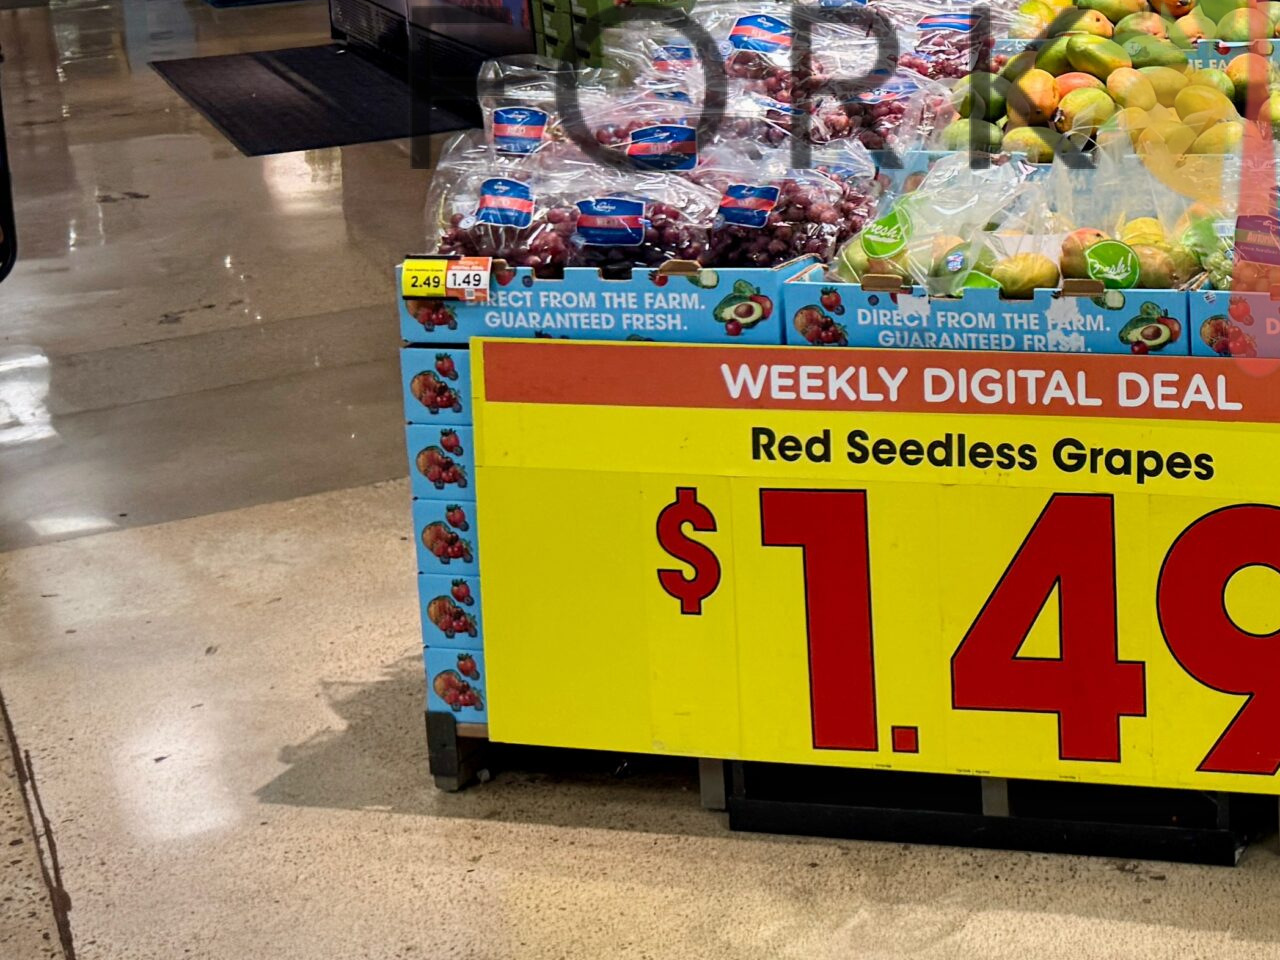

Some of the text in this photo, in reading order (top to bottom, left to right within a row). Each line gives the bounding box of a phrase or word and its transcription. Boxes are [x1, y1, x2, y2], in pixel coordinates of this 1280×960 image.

[411, 273, 482, 288] 2.49 1.49
[540, 291, 706, 310] FROM THE FARM.
[485, 311, 688, 331] GUARANTEED FRESH.
[857, 307, 1111, 333] DIRECT FROM THE FARM.
[878, 330, 1016, 351] GUARANTEED
[720, 362, 1243, 411] WEEKLY DIGITAL DEAL
[751, 427, 1216, 486] Red Seedless Grapes
